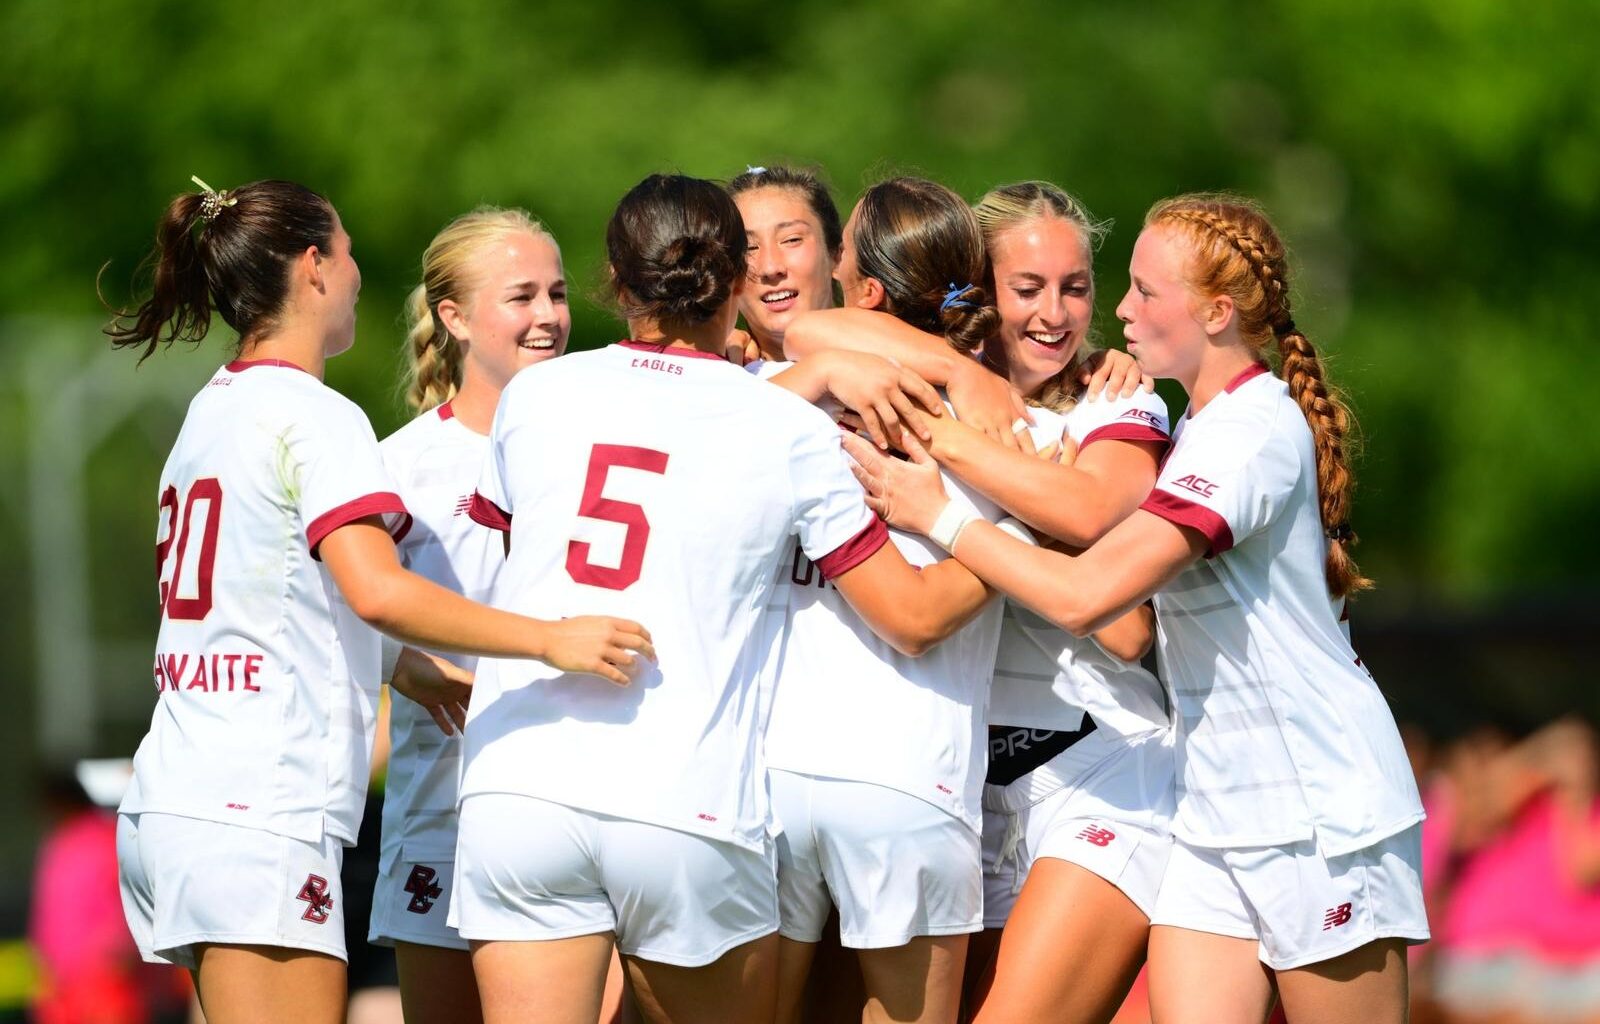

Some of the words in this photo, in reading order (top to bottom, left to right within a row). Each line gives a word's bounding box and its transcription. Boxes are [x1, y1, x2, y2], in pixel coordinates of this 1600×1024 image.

[631, 358, 684, 376] EAGLES
[1120, 408, 1162, 426] ACC
[1175, 474, 1220, 496] ACC
[564, 442, 670, 591] 5
